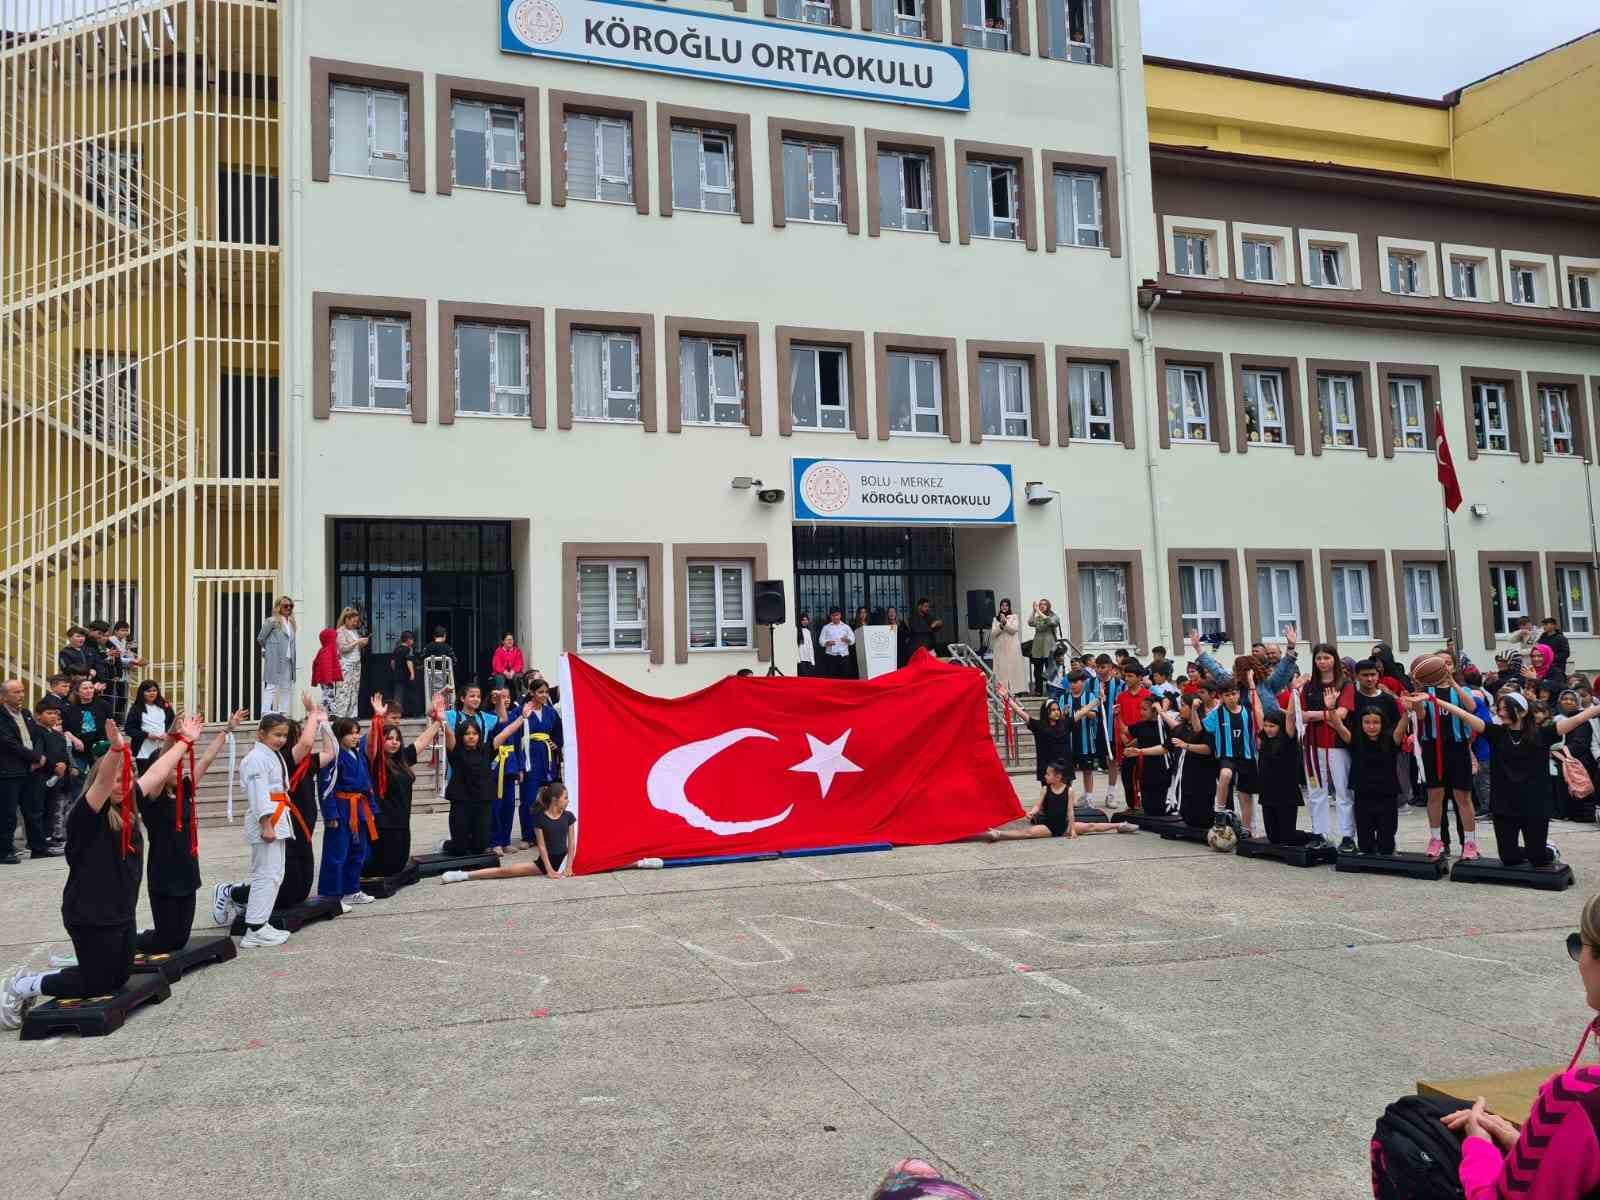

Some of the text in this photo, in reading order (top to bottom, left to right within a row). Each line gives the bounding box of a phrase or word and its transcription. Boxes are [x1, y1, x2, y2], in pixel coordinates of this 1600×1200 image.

[585, 17, 933, 89] KÖROĞLU ORTAOKULU
[861, 475, 891, 487] BOLU
[900, 477, 944, 488] MERKEZ
[861, 492, 991, 506] KÖROĞLU ORTAOKULU
[1232, 729, 1241, 738] 17
